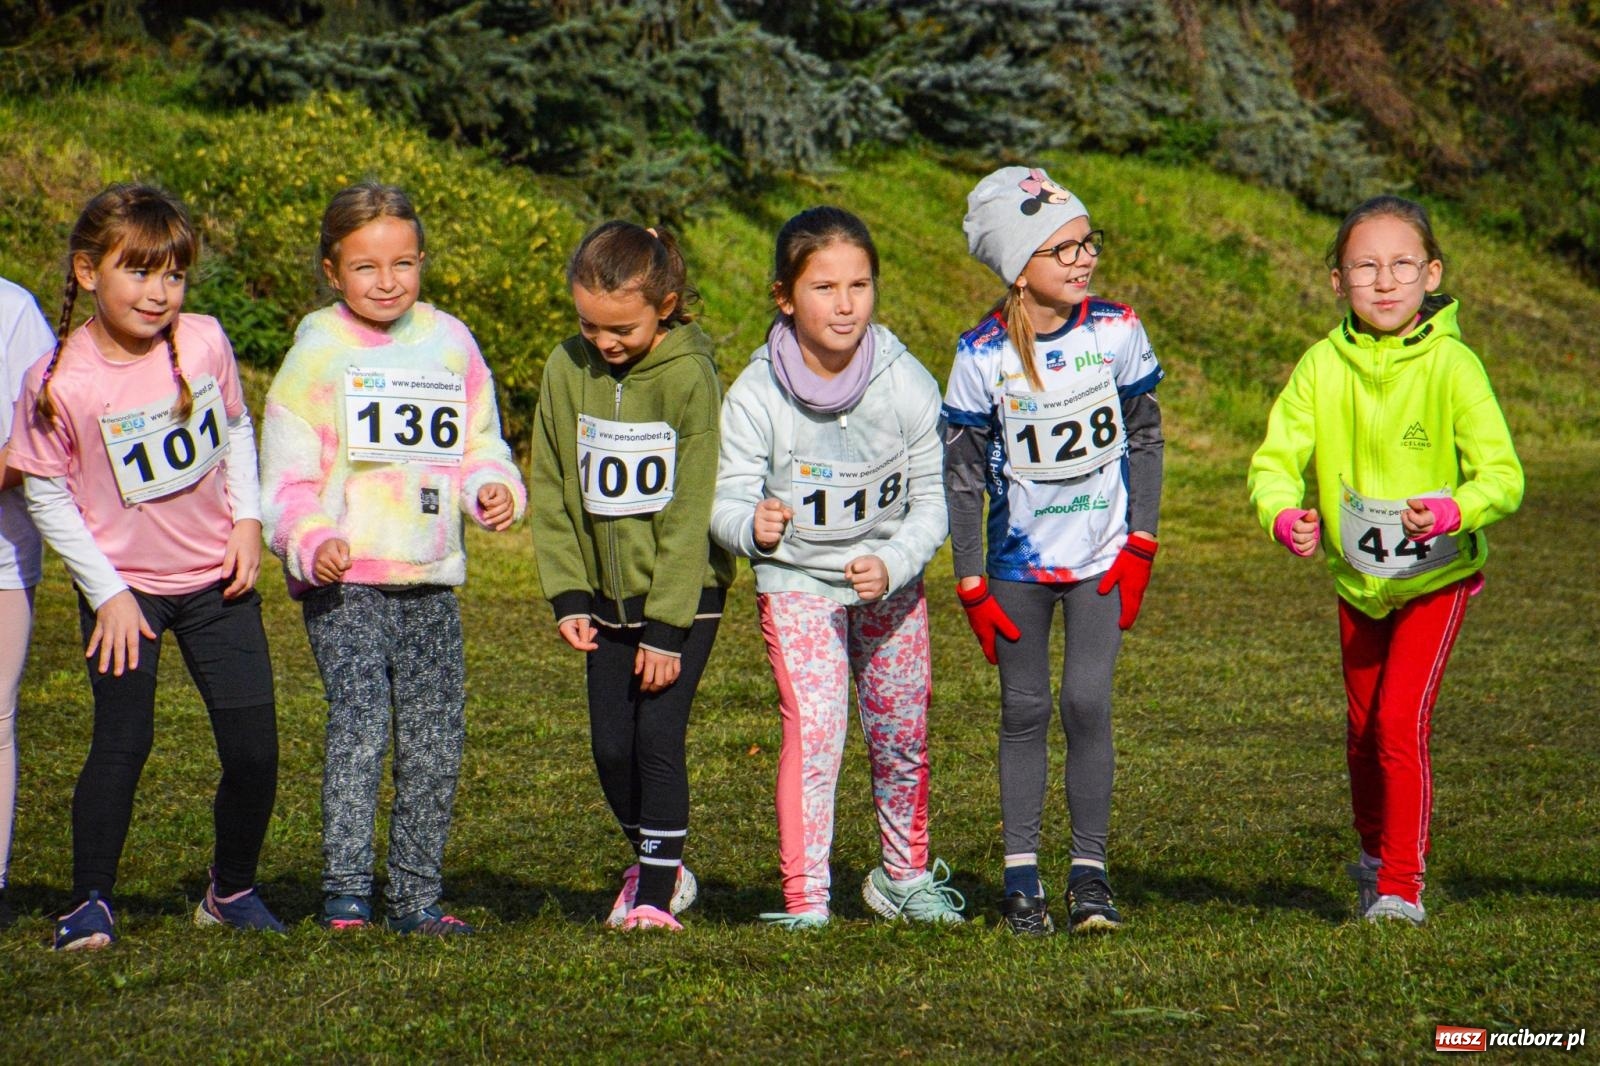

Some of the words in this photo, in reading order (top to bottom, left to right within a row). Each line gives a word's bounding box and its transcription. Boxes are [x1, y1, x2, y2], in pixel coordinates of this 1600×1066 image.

[391, 379, 462, 392] www.personalbest.pl
[1042, 379, 1111, 410] www.personalbest.pl
[357, 401, 460, 449] 136
[1015, 405, 1117, 464] 128
[122, 407, 221, 483] 101
[580, 451, 667, 498] 100
[802, 471, 902, 526] 118
[1034, 502, 1091, 518] PRODUCTS
[1072, 494, 1091, 505] AIR
[1357, 526, 1432, 563] 44
[640, 838, 662, 854] 4F
